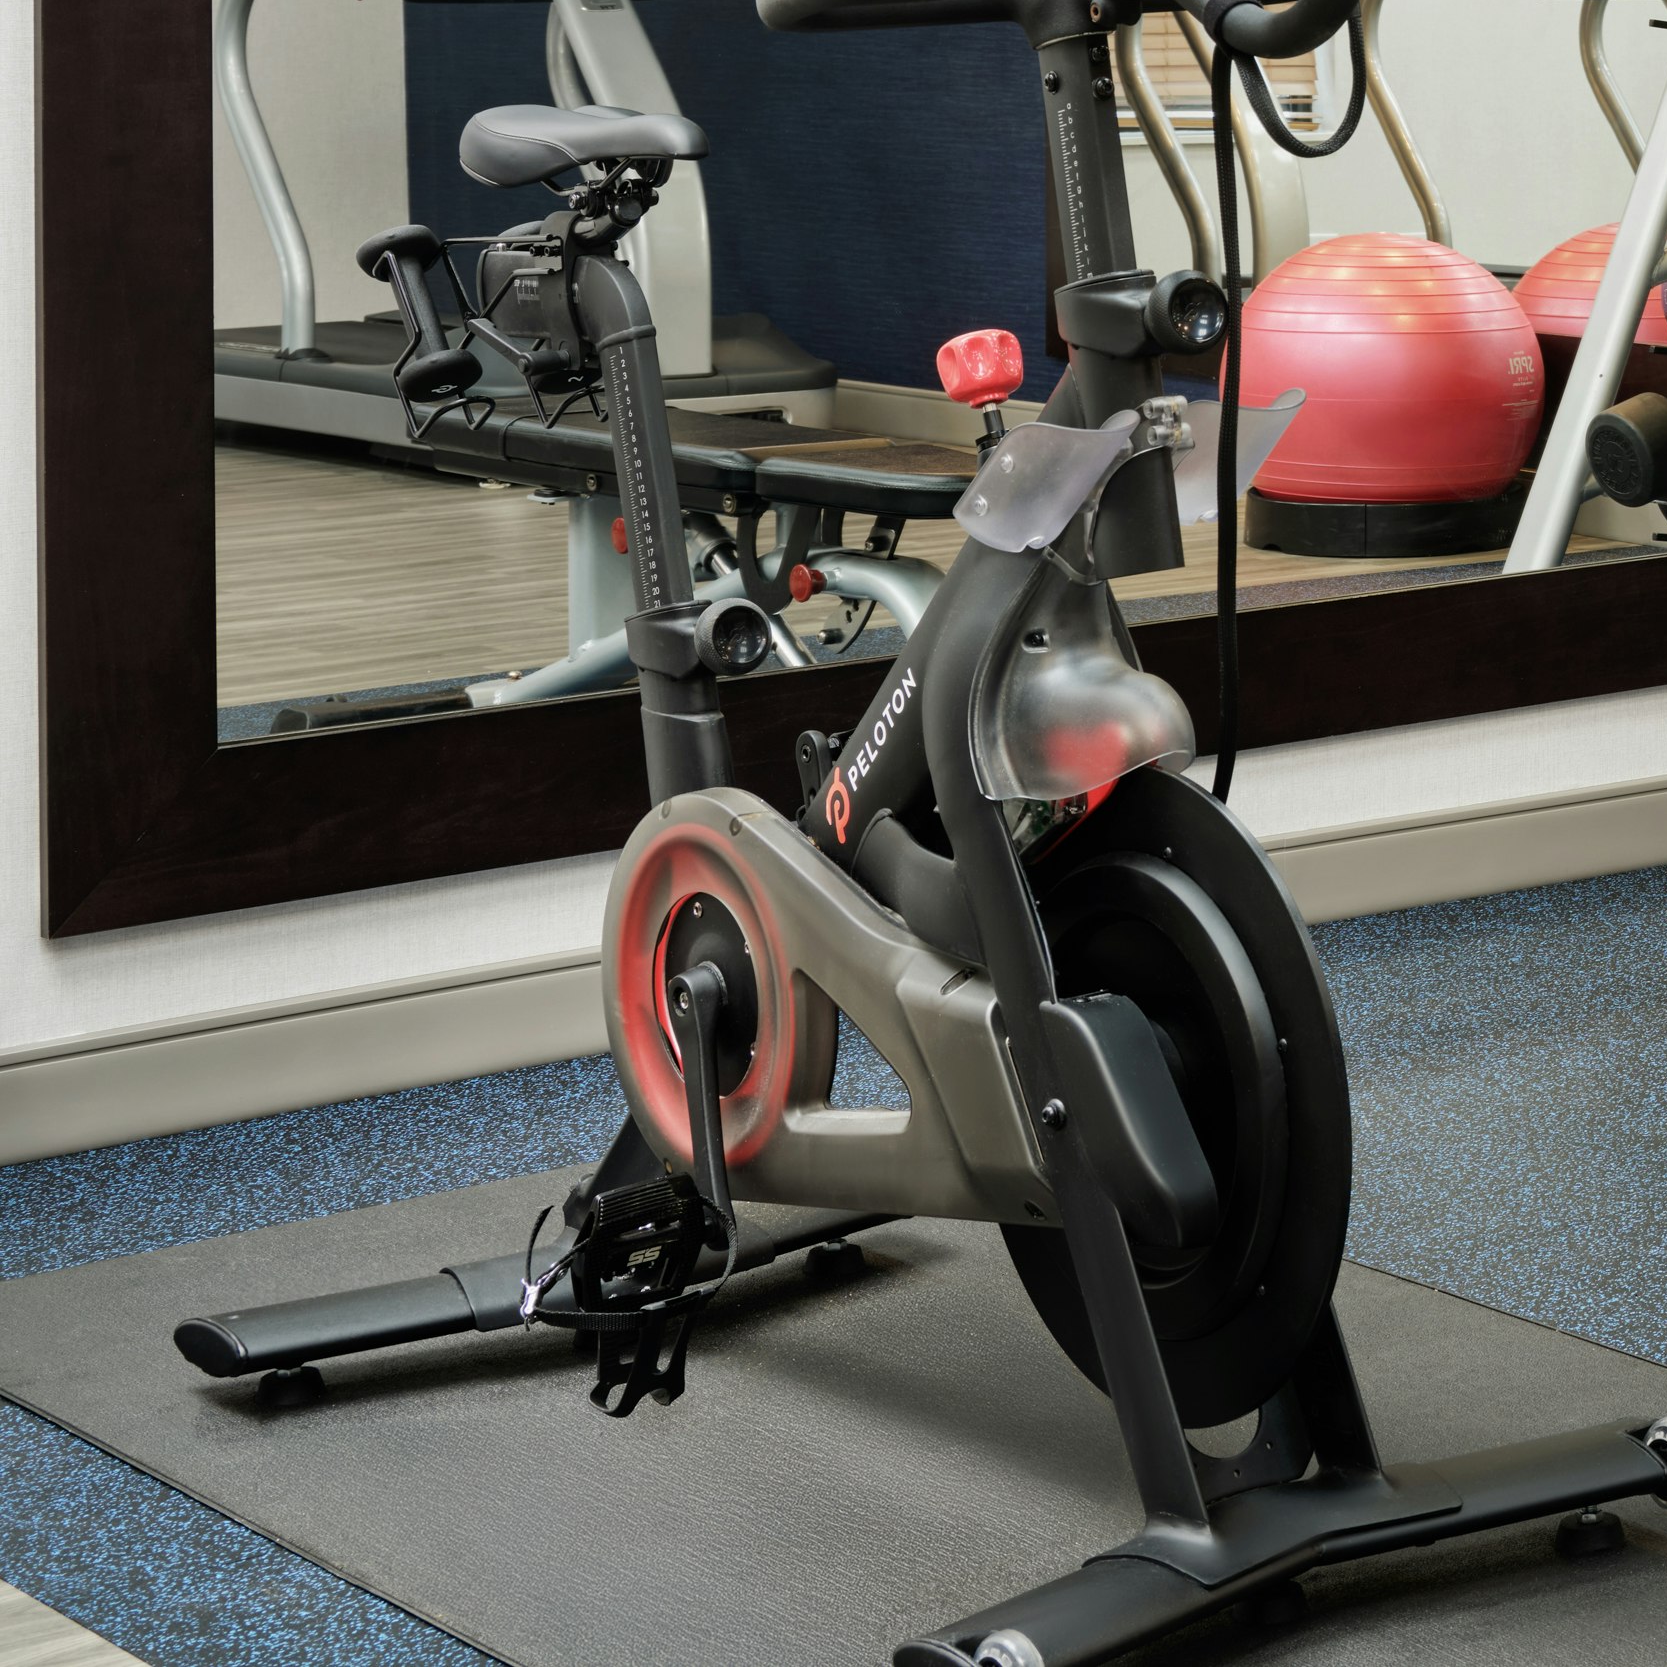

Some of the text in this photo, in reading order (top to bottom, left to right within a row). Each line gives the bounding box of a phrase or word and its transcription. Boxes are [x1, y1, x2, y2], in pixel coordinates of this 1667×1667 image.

[619, 346, 623, 354] 1
[620, 359, 626, 368] 2
[622, 371, 628, 380] 3
[624, 384, 629, 392] 4
[626, 396, 631, 405] 5
[628, 409, 633, 417] 6
[629, 422, 634, 430] 7
[631, 434, 637, 443] 8
[633, 447, 638, 455] 9
[634, 459, 642, 468] 10
[636, 472, 643, 481] 11
[637, 484, 645, 493] 12
[639, 497, 647, 506] 13
[641, 510, 649, 519] 14
[643, 522, 651, 532] 15
[645, 535, 653, 544] 16
[647, 548, 654, 557] 17
[648, 561, 656, 570] 18
[650, 574, 658, 583] 19
[652, 587, 660, 596] 20
[653, 599, 661, 609] 21
[847, 667, 918, 792] PELOTON
